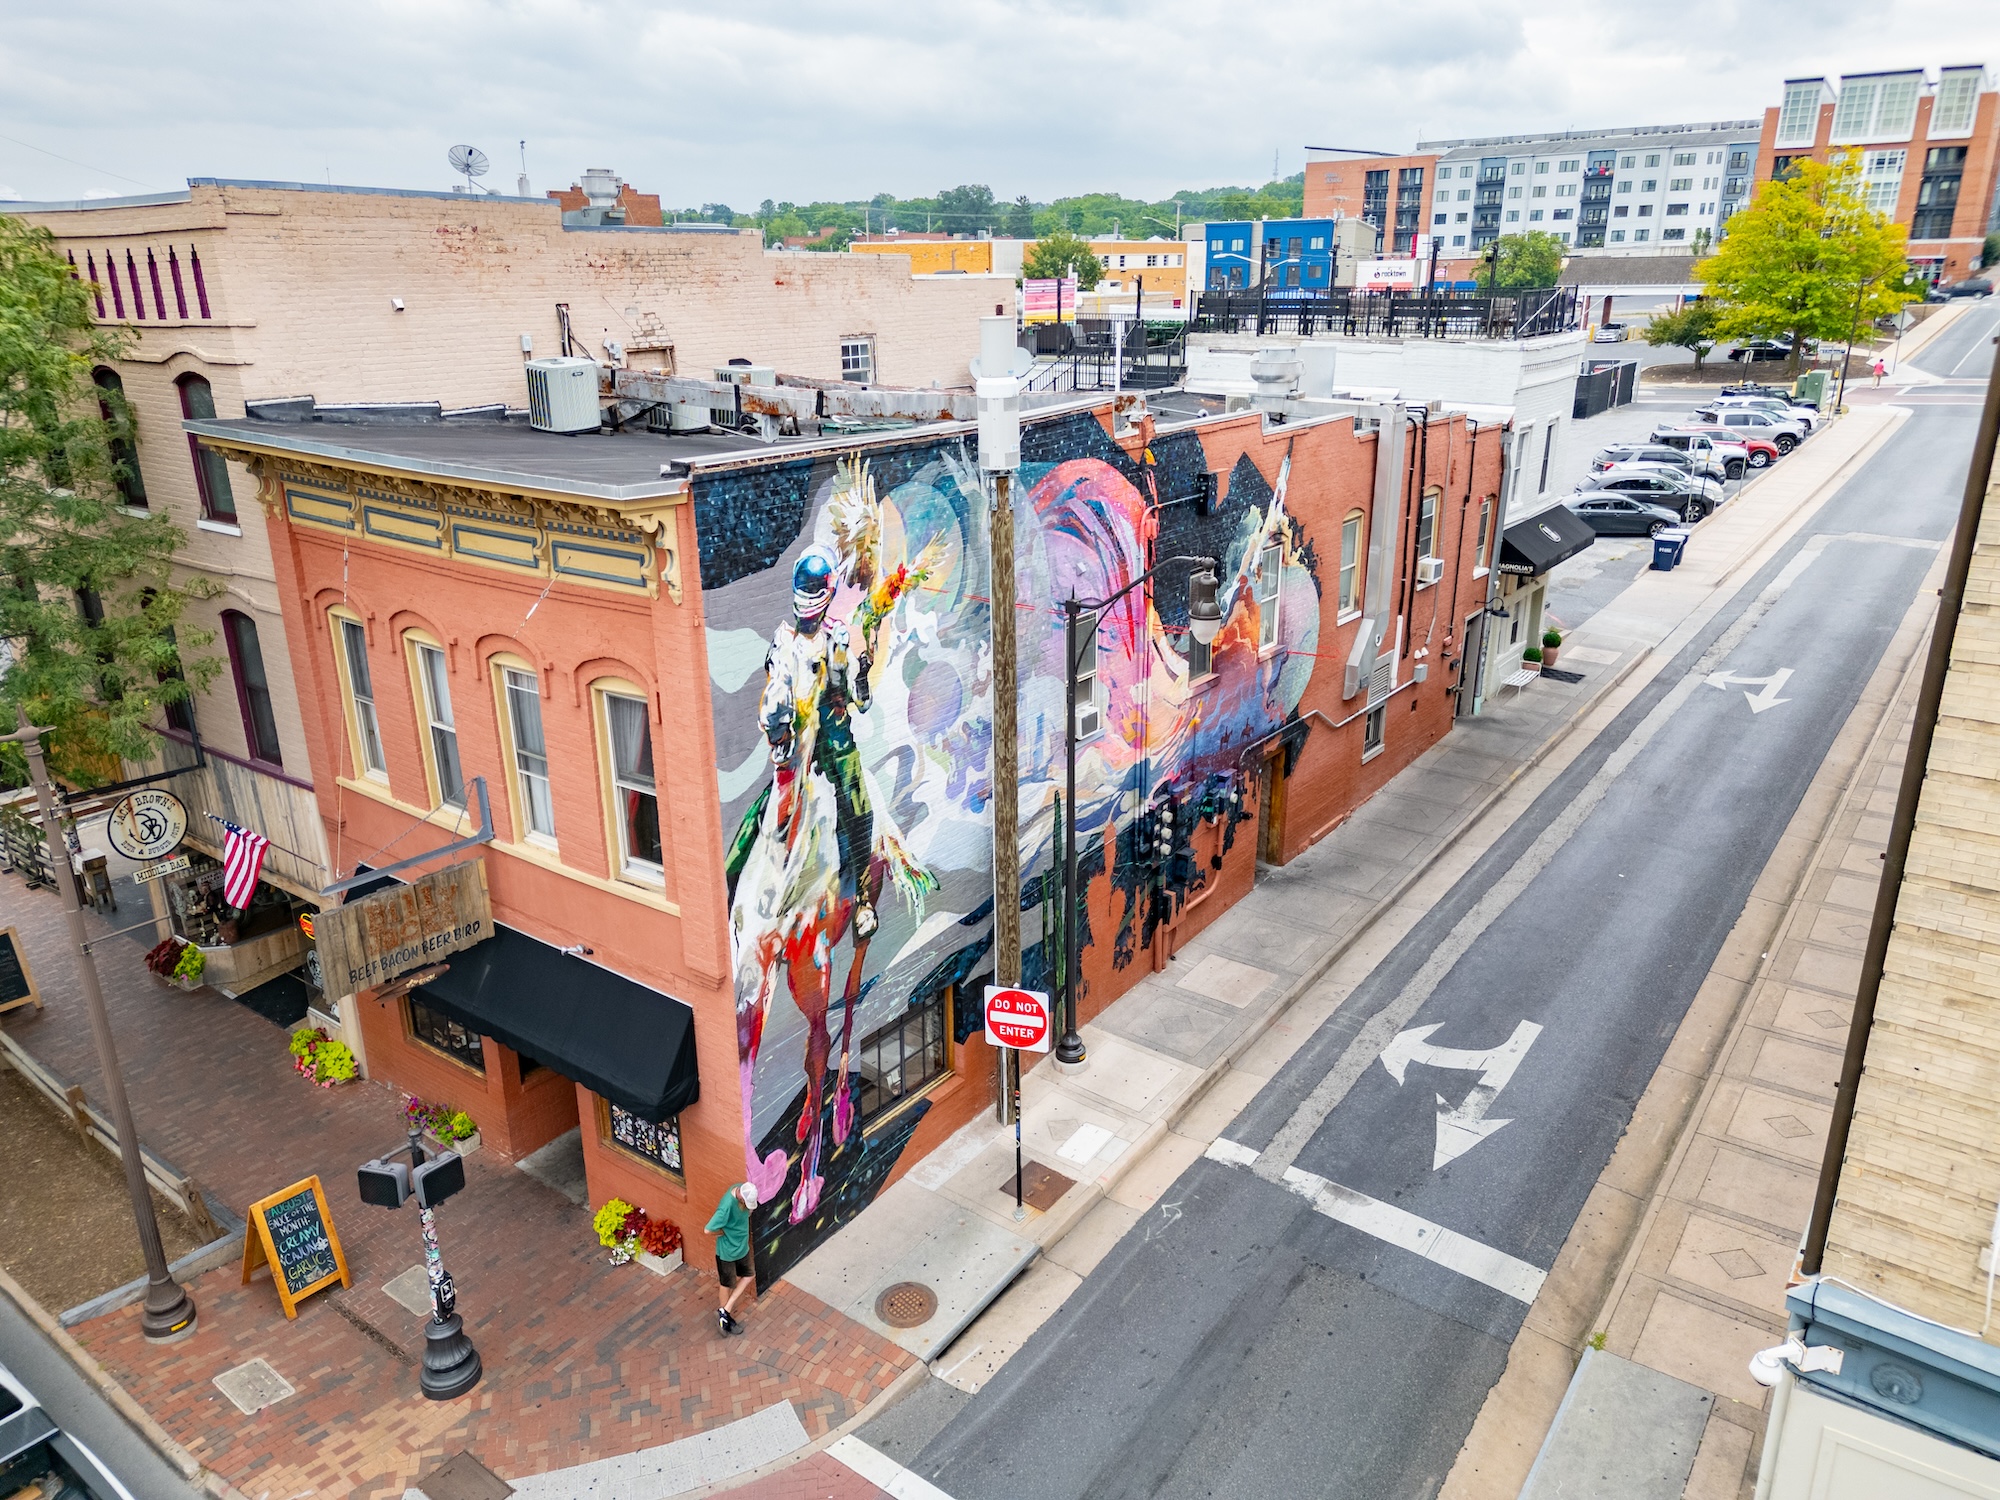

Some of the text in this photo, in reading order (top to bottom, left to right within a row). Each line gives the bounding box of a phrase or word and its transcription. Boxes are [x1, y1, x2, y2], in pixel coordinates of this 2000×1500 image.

[135, 795, 176, 813] BROWN'S
[121, 840, 136, 853] BEER
[148, 840, 172, 855] BURGER
[136, 858, 187, 882] MIDDLE BAR
[350, 960, 378, 985] BEEF
[380, 945, 419, 972] BACON
[421, 932, 451, 955] BEER
[453, 920, 481, 942] BIRD
[995, 999, 1038, 1013] DO NOT
[1000, 1025, 1034, 1039] ENTER
[270, 1193, 307, 1218] AUGUST
[300, 1200, 317, 1215] THE
[279, 1215, 311, 1237] MONTH:
[279, 1220, 320, 1254] CREAMY
[284, 1240, 318, 1265] CAJUN
[288, 1252, 326, 1280] GARLIC
